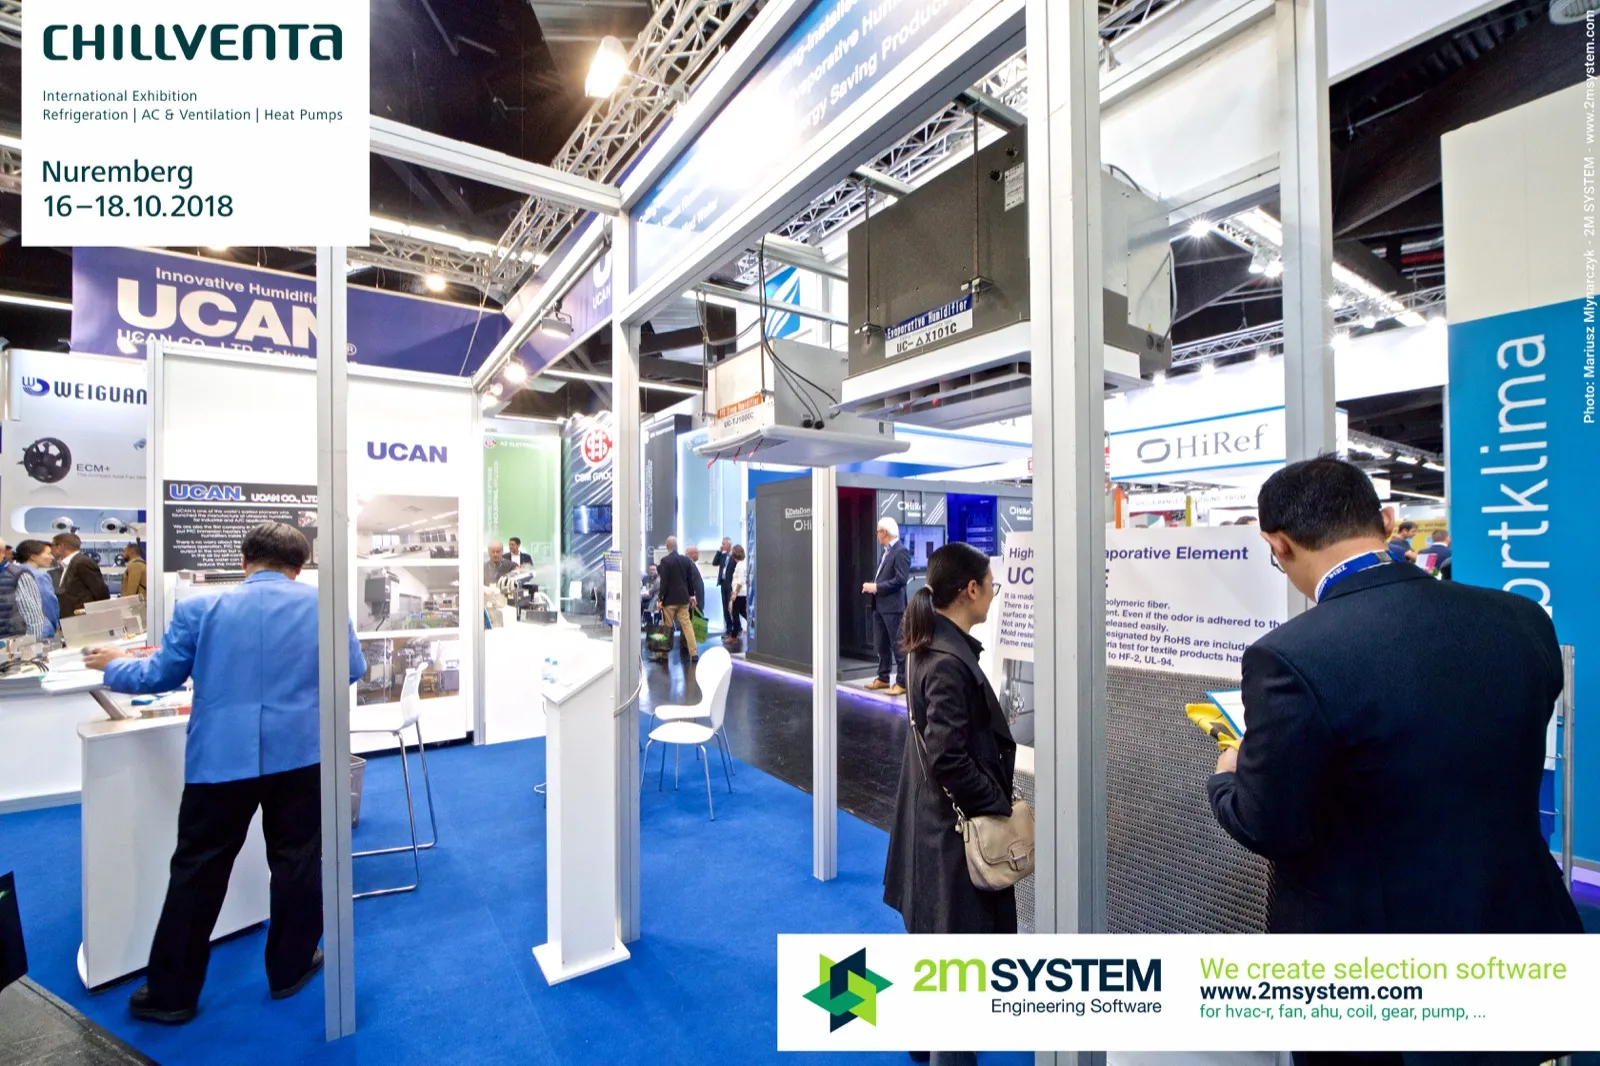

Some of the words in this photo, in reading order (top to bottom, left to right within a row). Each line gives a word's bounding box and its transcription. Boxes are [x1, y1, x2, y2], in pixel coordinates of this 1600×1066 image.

[830, 52, 878, 105] Saving
[156, 267, 245, 293] Innovative
[1176, 423, 1269, 459] HiRef
[367, 441, 447, 463] UCAN
[169, 483, 242, 500] UCAN
[1009, 547, 1034, 560] High
[1176, 546, 1248, 560] Element
[1147, 600, 1171, 610] fiber.
[1122, 610, 1143, 618] Even
[1145, 611, 1152, 619] if
[1154, 612, 1168, 620] the
[1171, 613, 1194, 623] odor
[1196, 614, 1204, 623] is
[1207, 615, 1251, 627] adhered
[1254, 618, 1265, 628] to
[1140, 622, 1169, 633] easily.
[1150, 633, 1161, 643] by
[1164, 634, 1191, 646] RoHS
[1193, 639, 1210, 648] are
[1118, 652, 1142, 664] HF-2,
[1144, 655, 1175, 667] UL-94.
[1119, 641, 1134, 651] test
[1136, 643, 1149, 652] for
[1150, 644, 1178, 656] textile
[1180, 649, 1223, 662] products
